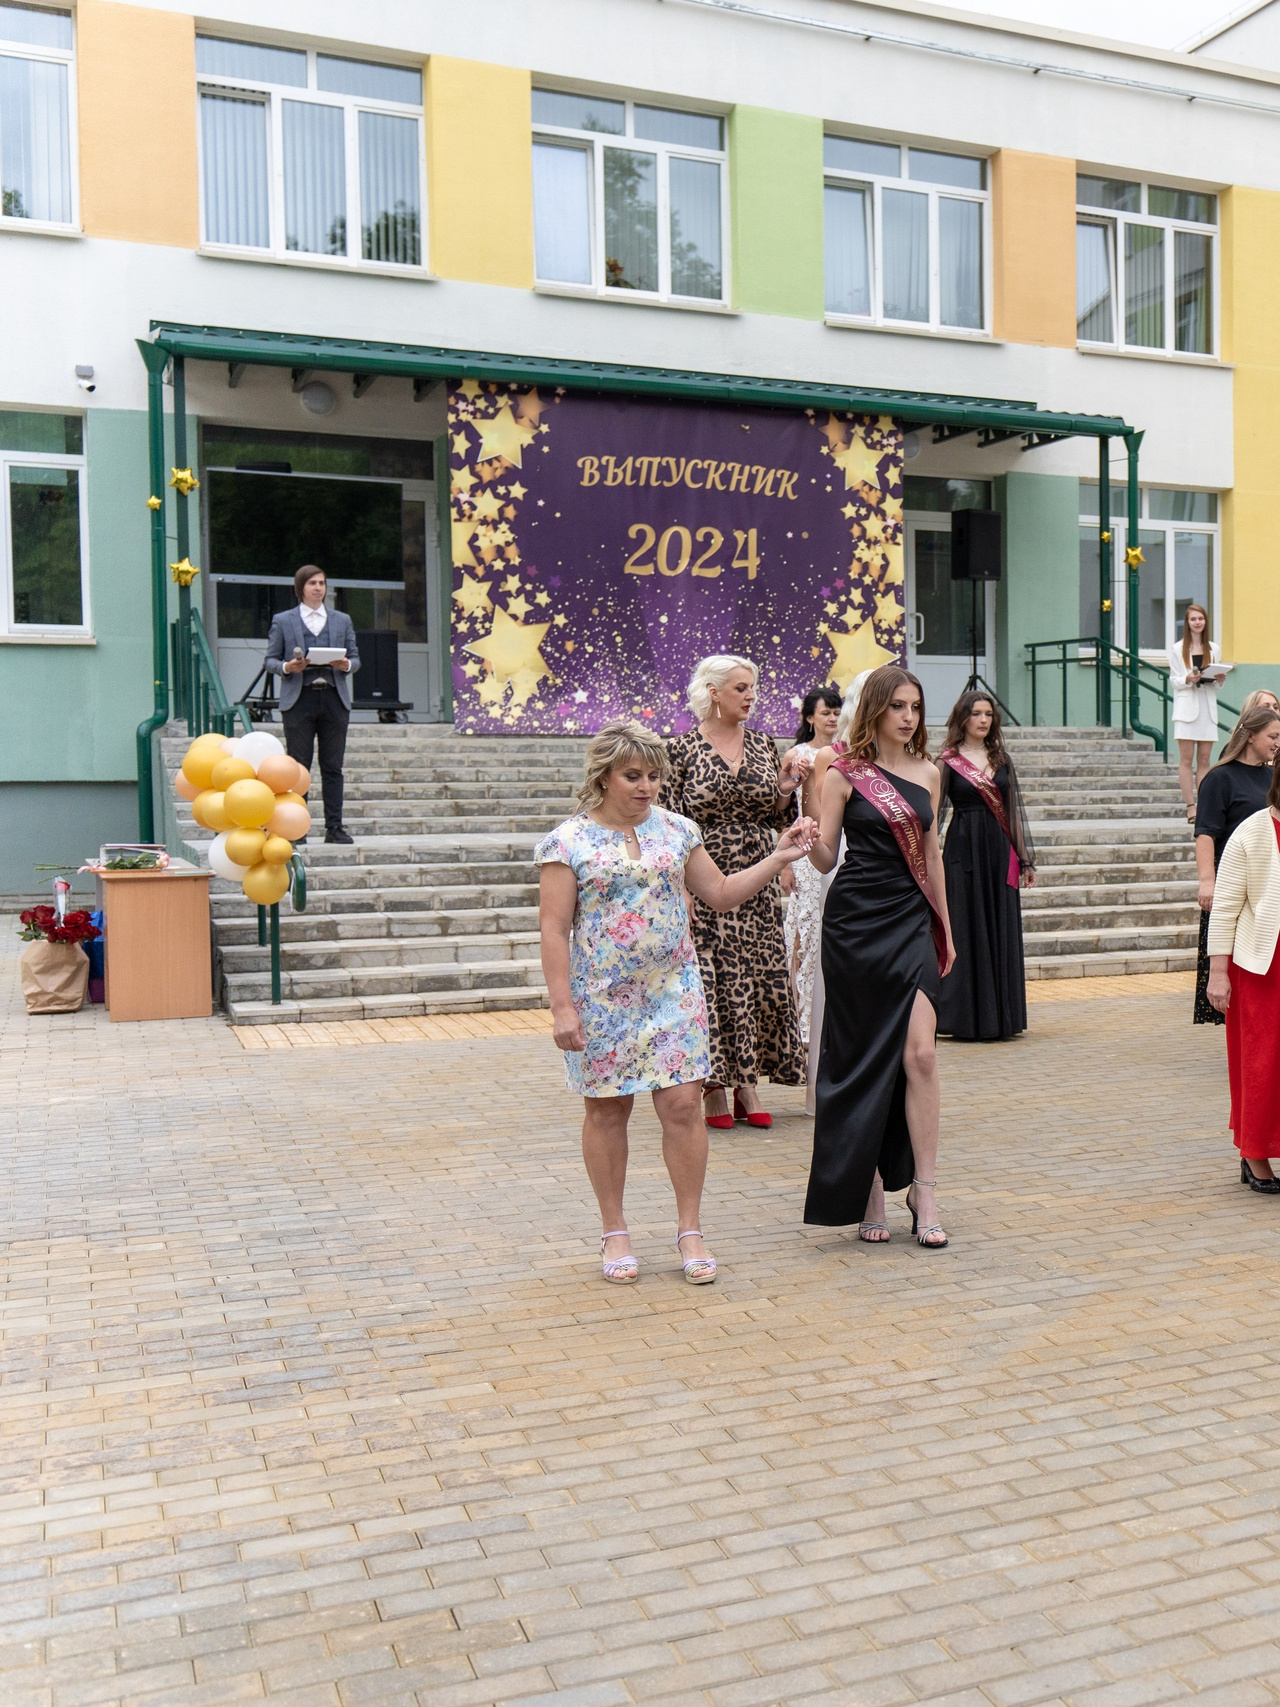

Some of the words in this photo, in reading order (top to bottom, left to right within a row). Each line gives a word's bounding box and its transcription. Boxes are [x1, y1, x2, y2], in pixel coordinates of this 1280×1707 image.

[577, 455, 799, 500] ВЫПУСКНИК
[624, 523, 761, 580] 2024
[869, 778, 919, 857] Выпускница
